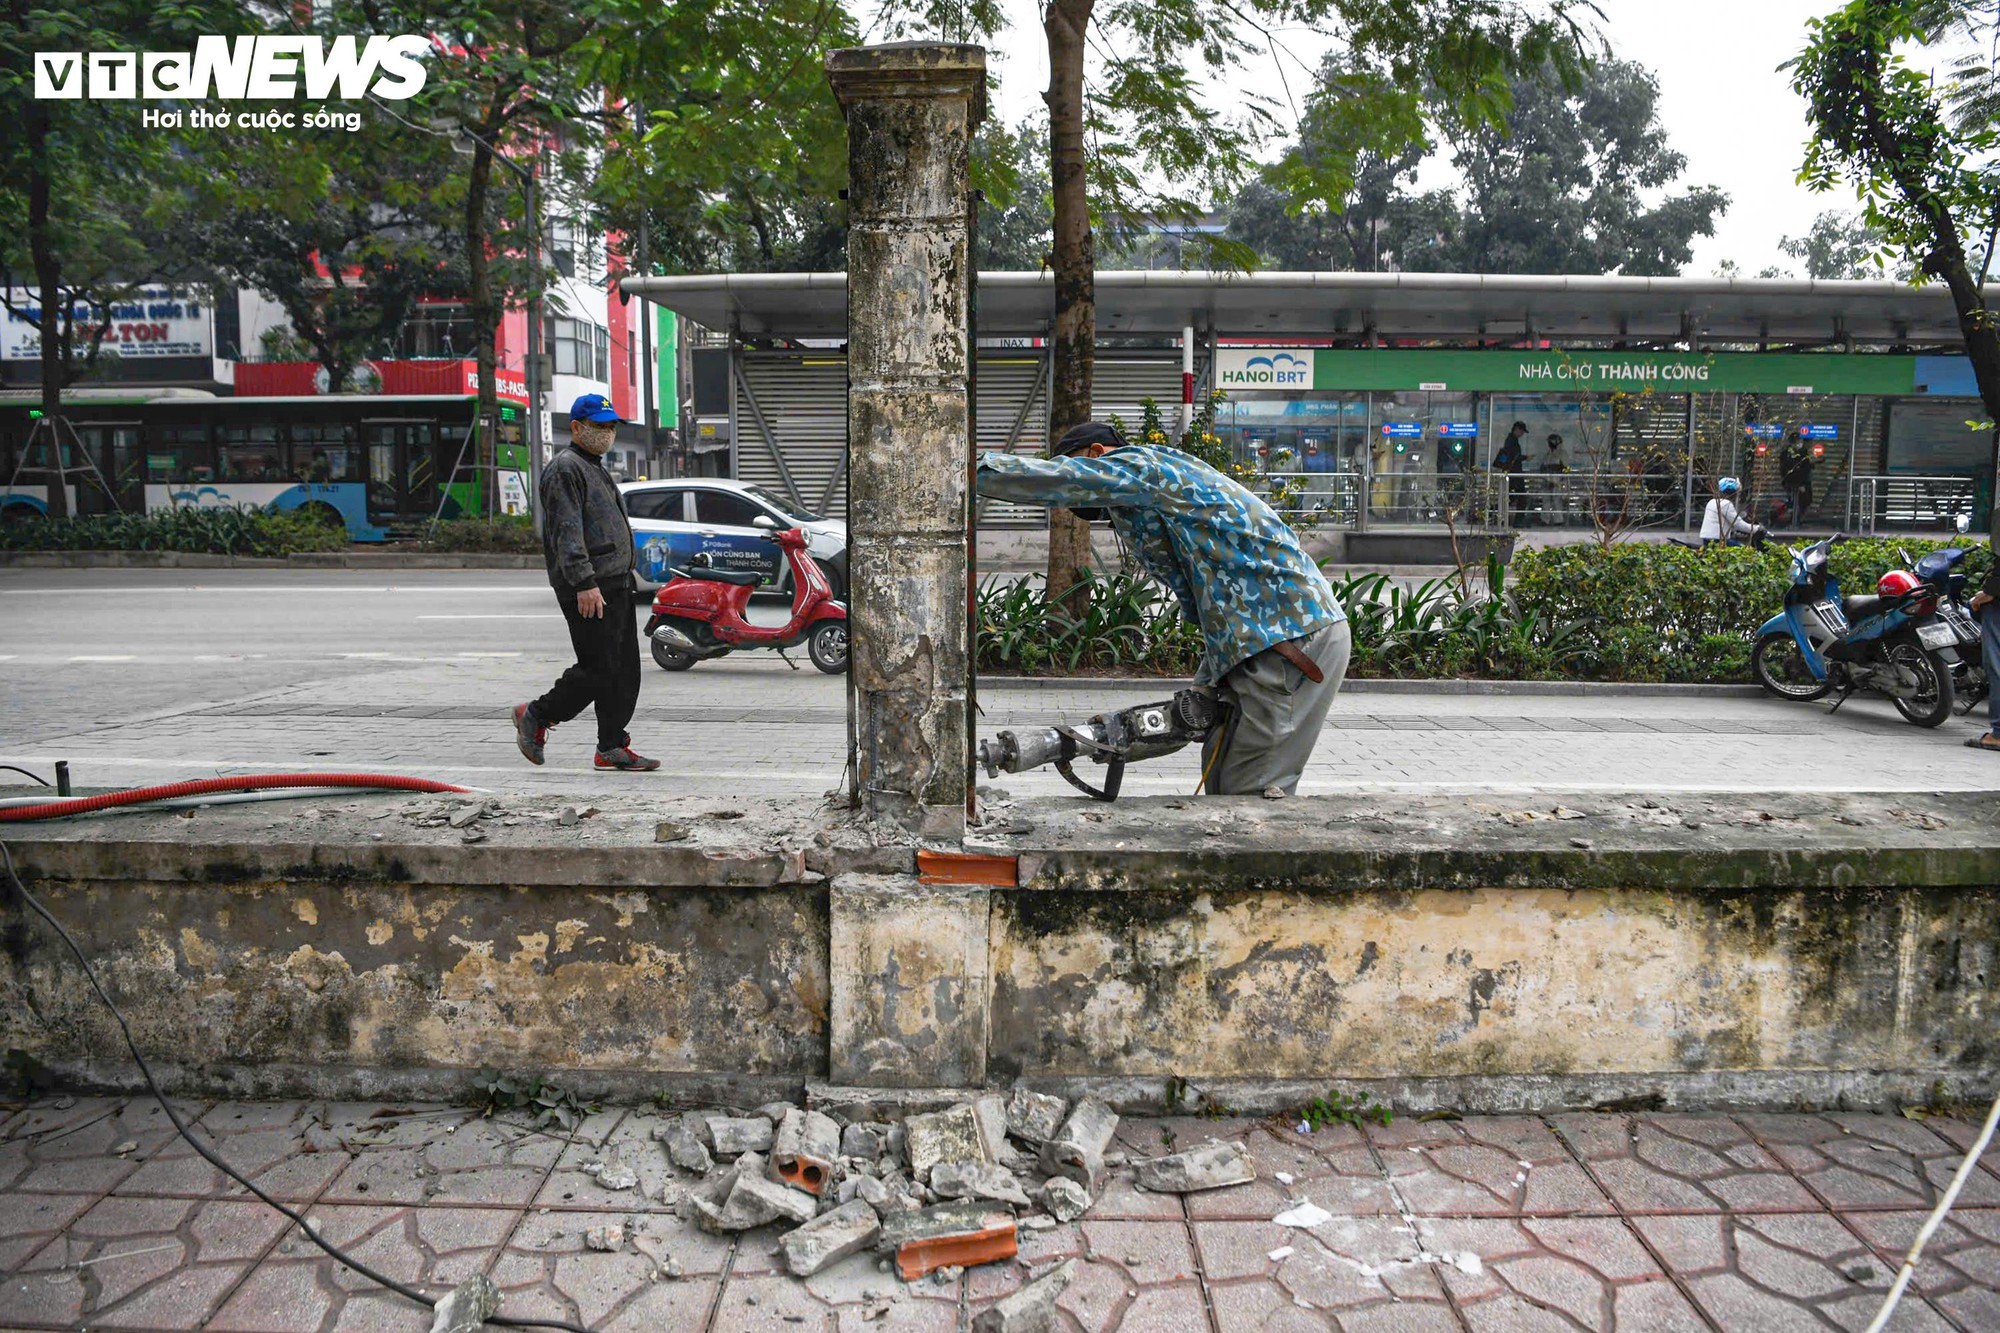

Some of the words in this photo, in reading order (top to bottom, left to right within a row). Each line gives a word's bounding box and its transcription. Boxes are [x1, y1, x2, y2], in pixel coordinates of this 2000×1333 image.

[1000, 339, 1024, 347] INAX
[1519, 361, 1552, 379] NHÀ
[1556, 362, 1593, 380] CHỜ
[1599, 361, 1658, 380] THÀNH
[1662, 362, 1709, 380] CÔNG
[1223, 371, 1274, 383] HANOI
[1276, 371, 1307, 383] BRT
[723, 549, 745, 558] CÙNG
[726, 559, 750, 567] THÀNH
[750, 560, 773, 568] CÔNG
